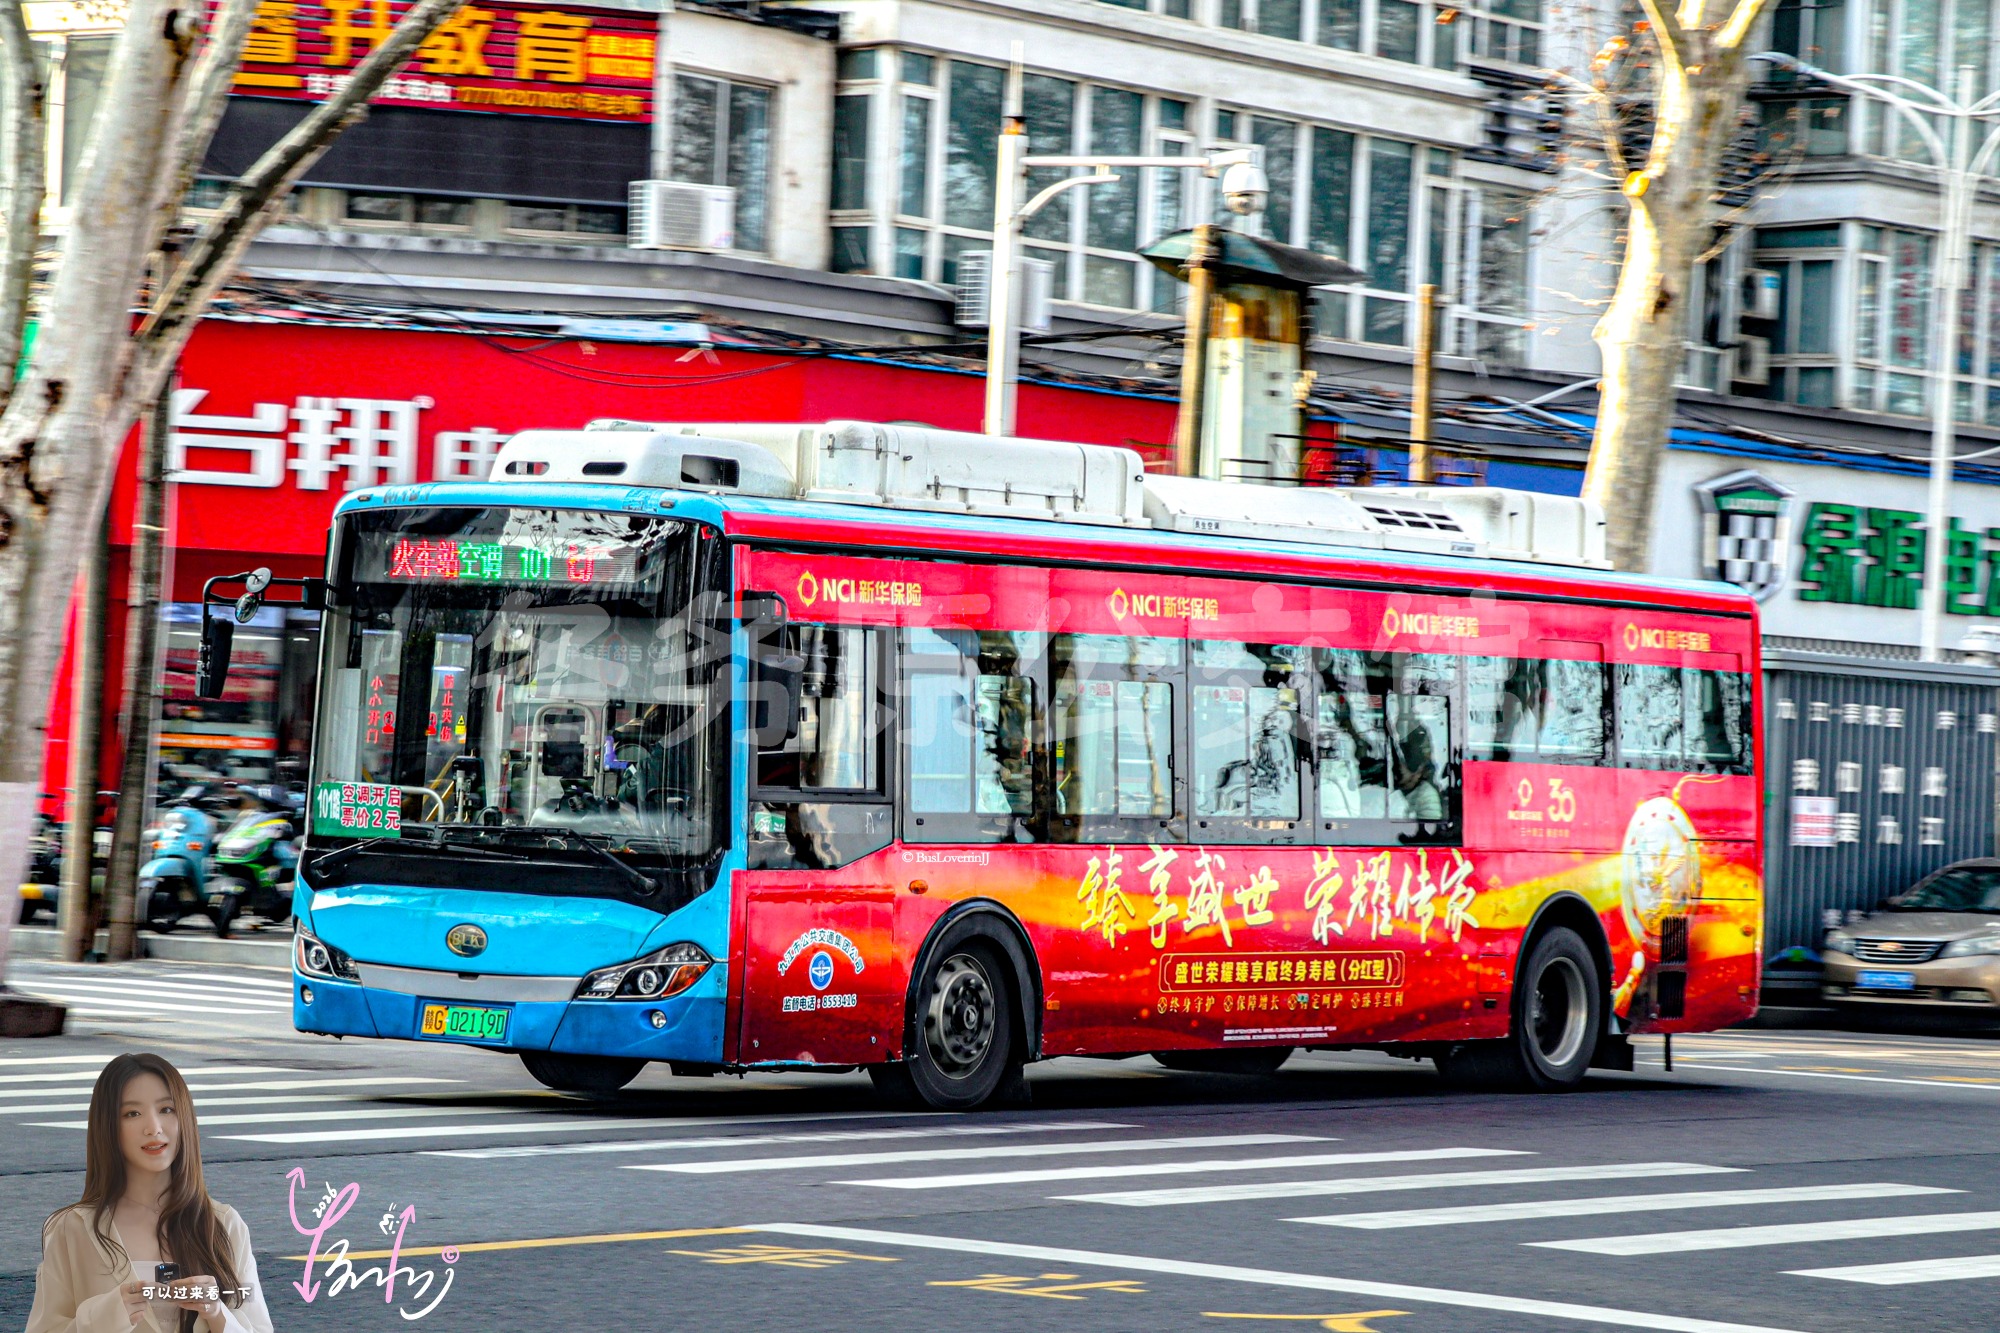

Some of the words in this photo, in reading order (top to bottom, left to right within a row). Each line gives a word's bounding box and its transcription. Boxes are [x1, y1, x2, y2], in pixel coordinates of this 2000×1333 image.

[519, 546, 552, 580] 101
[822, 578, 856, 603] NCI
[859, 580, 922, 606] 新华保险
[1131, 594, 1161, 617] NCI
[1163, 596, 1219, 621] 新华保险
[1402, 613, 1429, 635] NCI
[1430, 615, 1480, 638] 新华保险
[1640, 628, 1665, 648] NCI
[1666, 630, 1712, 652] 新华保险
[342, 784, 402, 808] 空调开启
[341, 806, 401, 830] 票价2元
[1077, 842, 1280, 949] 臻享盛世
[1304, 846, 1480, 947] 荣耀传家
[778, 927, 865, 977] 九江市公共交通集团公司
[1169, 995, 1215, 1013] 终身守护
[1237, 993, 1279, 1011] 保障增长
[450, 1011, 506, 1035] 02119D
